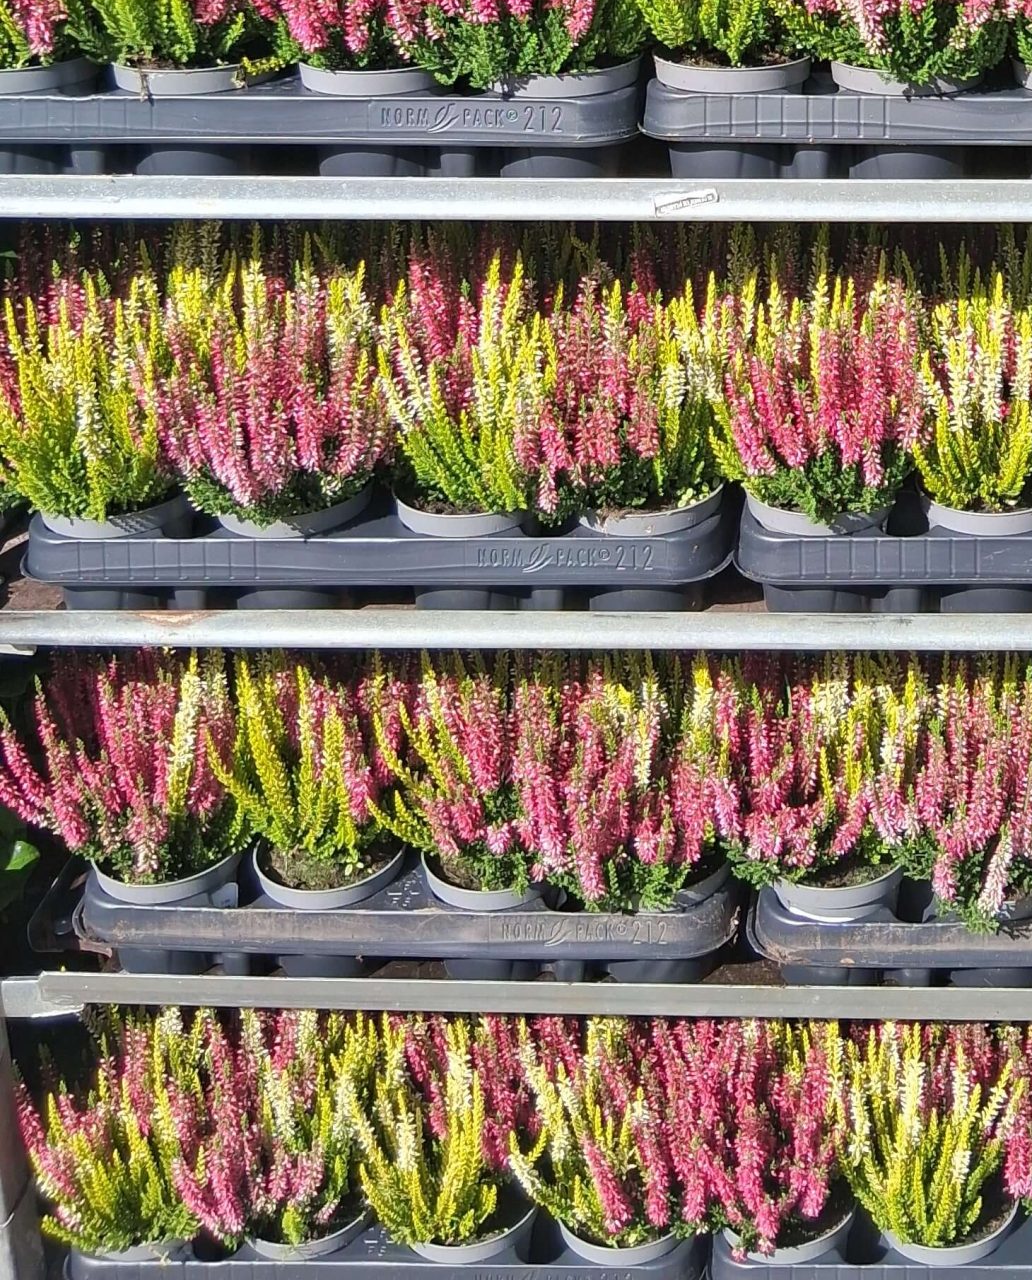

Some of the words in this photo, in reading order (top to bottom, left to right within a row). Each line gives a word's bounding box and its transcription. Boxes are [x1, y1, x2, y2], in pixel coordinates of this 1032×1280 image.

[381, 107, 430, 128] NORM
[523, 105, 563, 133] 212
[477, 547, 525, 568] NORM
[615, 545, 654, 571] 212
[503, 922, 546, 941] NORM
[632, 920, 668, 945] 212
